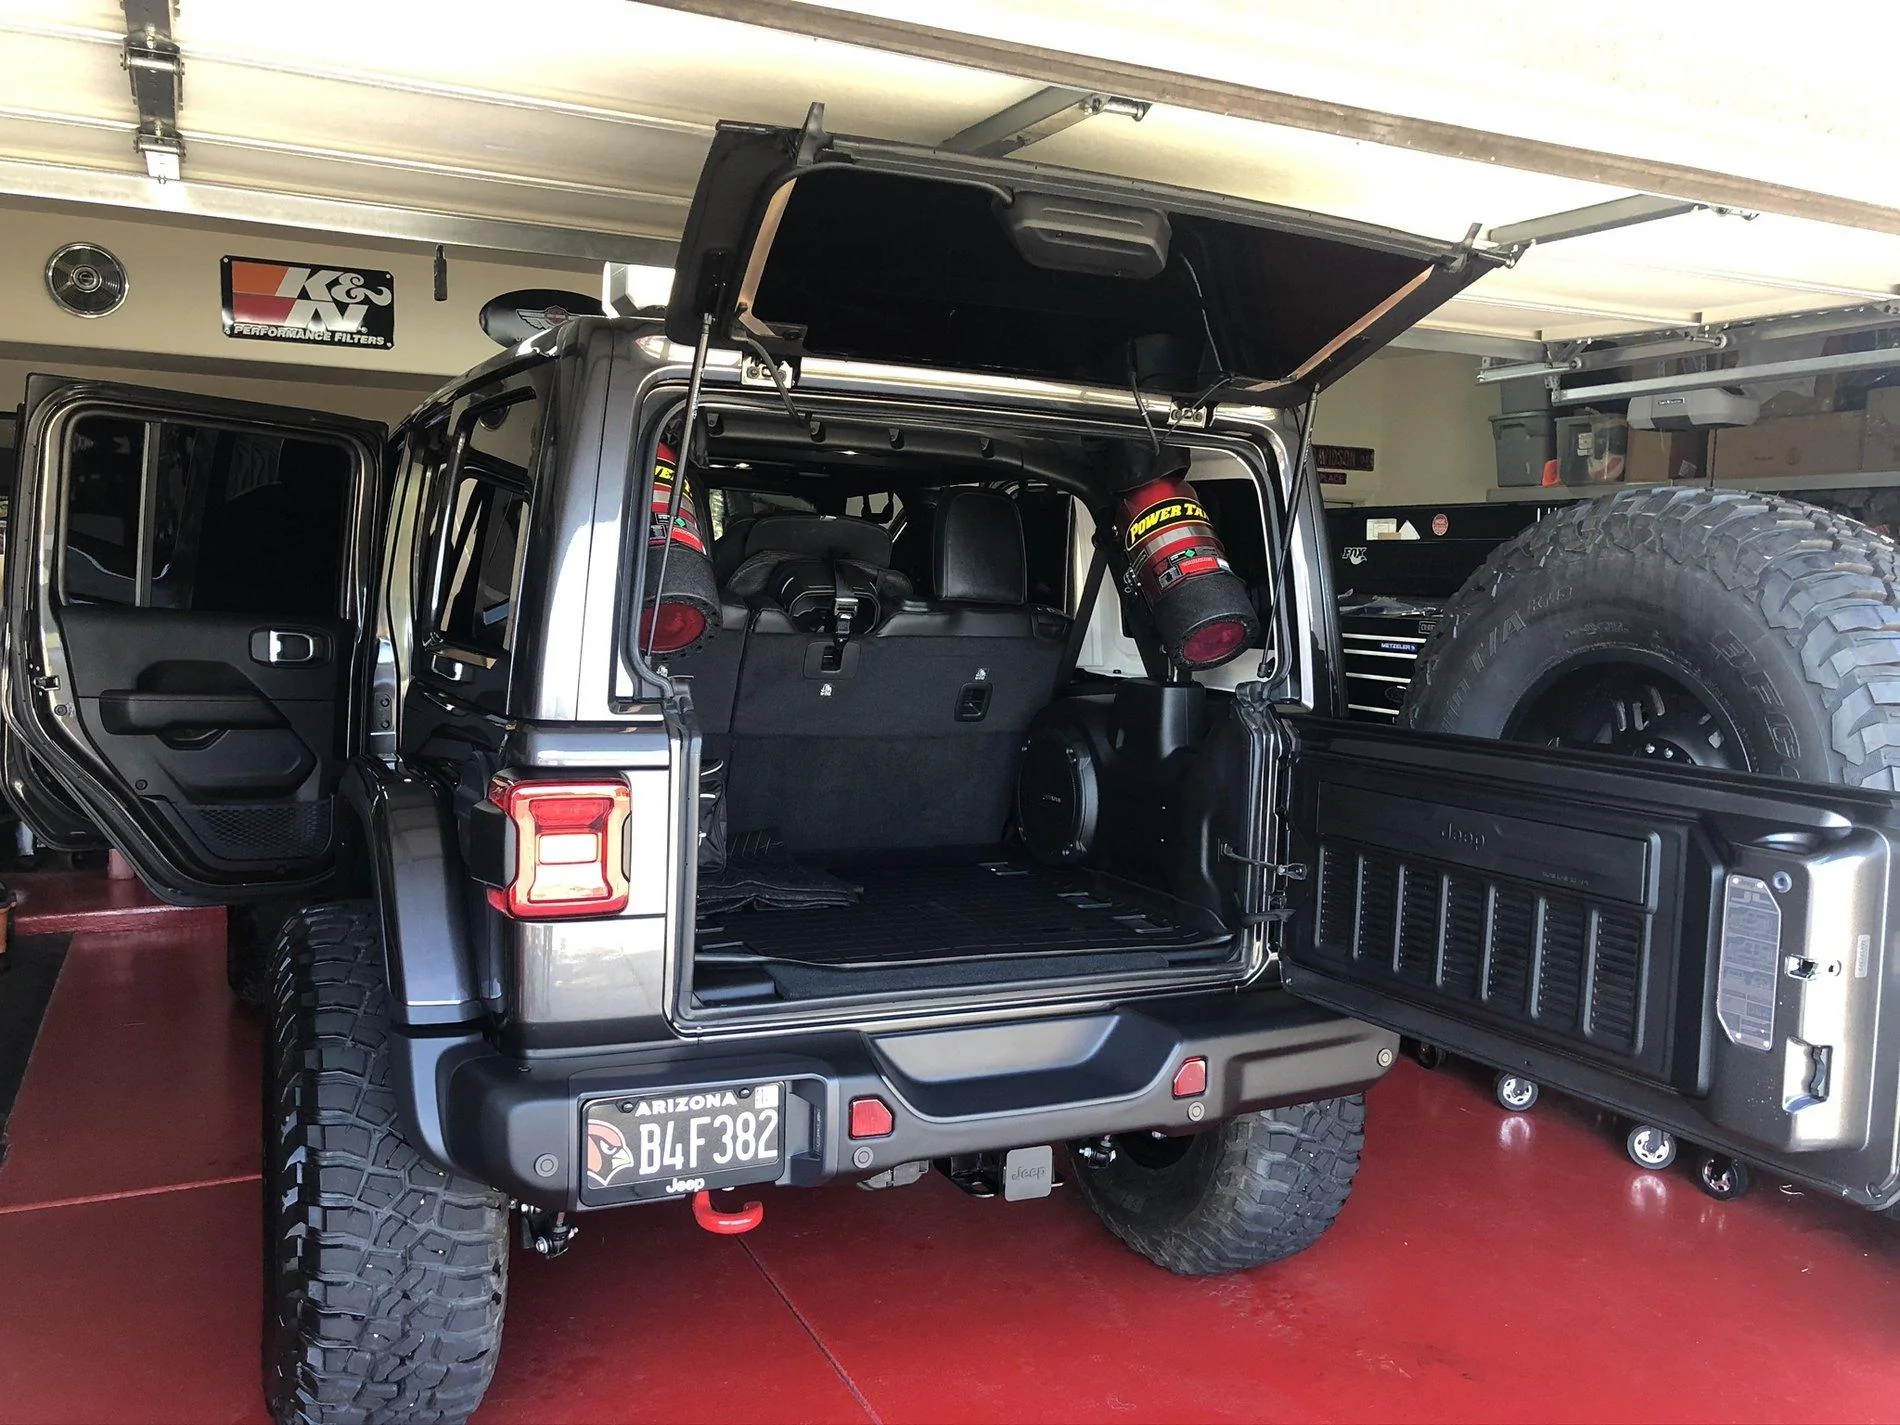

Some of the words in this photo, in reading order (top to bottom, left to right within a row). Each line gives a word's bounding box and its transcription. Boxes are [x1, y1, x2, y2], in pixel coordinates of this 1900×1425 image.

[233, 322, 331, 342] PERFORMANCE
[334, 332, 385, 346] FILTERS
[1130, 505, 1182, 544] POWER
[1342, 547, 1368, 560] FOX
[1381, 643, 1411, 651] METZELER
[1441, 823, 1485, 851] Jeep
[635, 1091, 738, 1118] ARIZONA
[638, 1109, 779, 1176] B4F382
[665, 1177, 705, 1194] Jeep
[1011, 1166, 1046, 1181] Jeep
